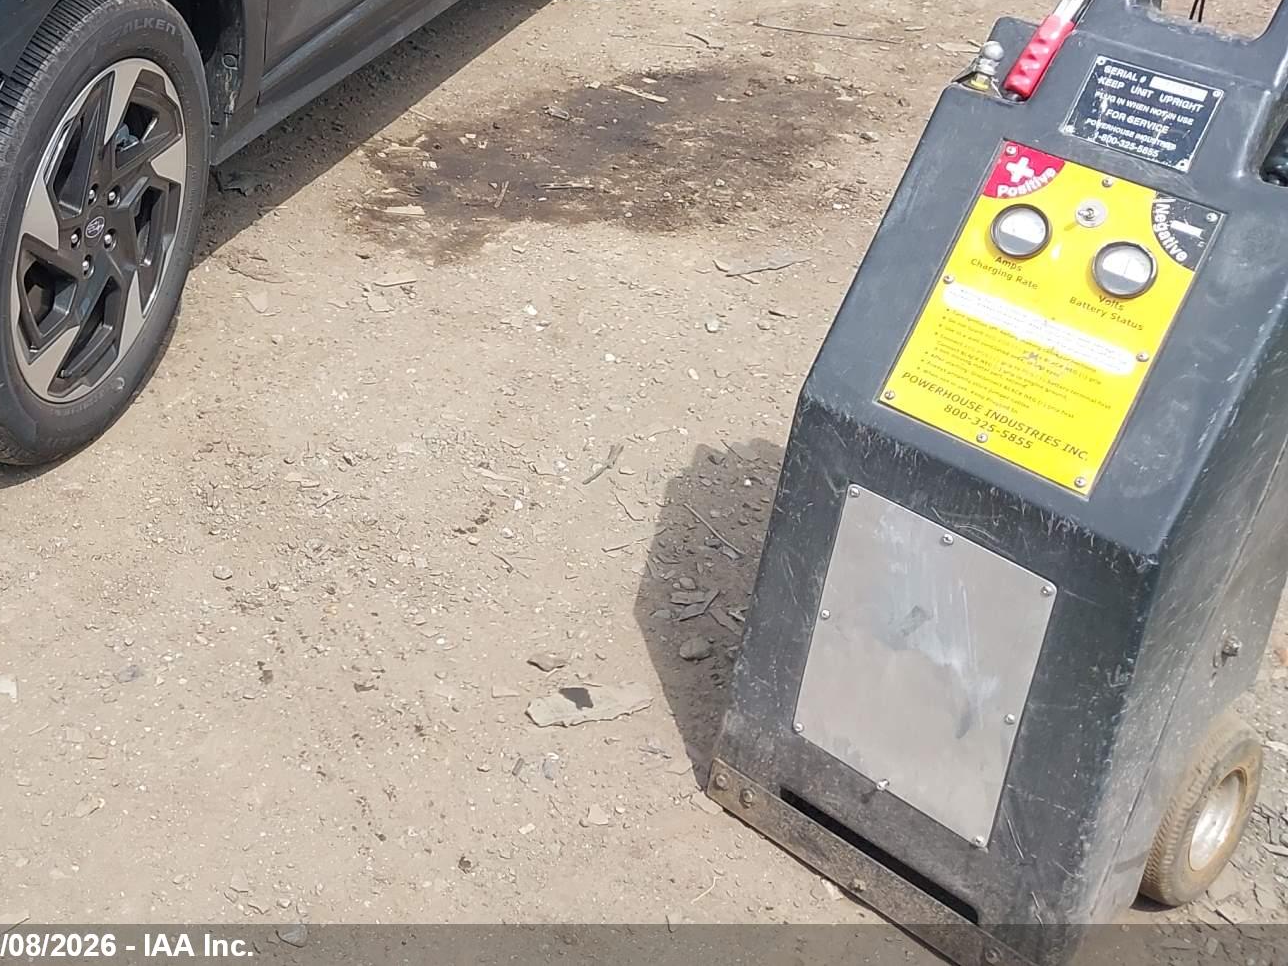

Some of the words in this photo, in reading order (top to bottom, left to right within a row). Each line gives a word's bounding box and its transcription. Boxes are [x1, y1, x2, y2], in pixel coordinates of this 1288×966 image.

[1104, 65, 1138, 82] SERIAL
[1097, 75, 1125, 89] KEEP
[1130, 85, 1154, 98] UNIT
[1159, 93, 1205, 113] UPRIGHT
[1105, 108, 1125, 122] FOR
[1127, 115, 1170, 135] SERVICE
[1116, 97, 1125, 106] IN
[1126, 99, 1149, 113] WHEN
[1176, 115, 1194, 126] USE
[1085, 117, 1135, 138] POWERHOUSE
[997, 167, 1056, 197] Positive
[1154, 203, 1188, 262] Negative
[970, 258, 1013, 281] Charging
[1016, 275, 1038, 289] Rate
[995, 256, 1023, 272] Amps
[1069, 296, 1107, 318] Battery
[1111, 312, 1144, 331] Status
[1098, 295, 1125, 311] Volts
[902, 371, 982, 412] POWERHOUSE
[984, 409, 1063, 448] INDUSTRIES
[1063, 442, 1089, 461] INC.
[943, 404, 1033, 450] 800-325-5855
